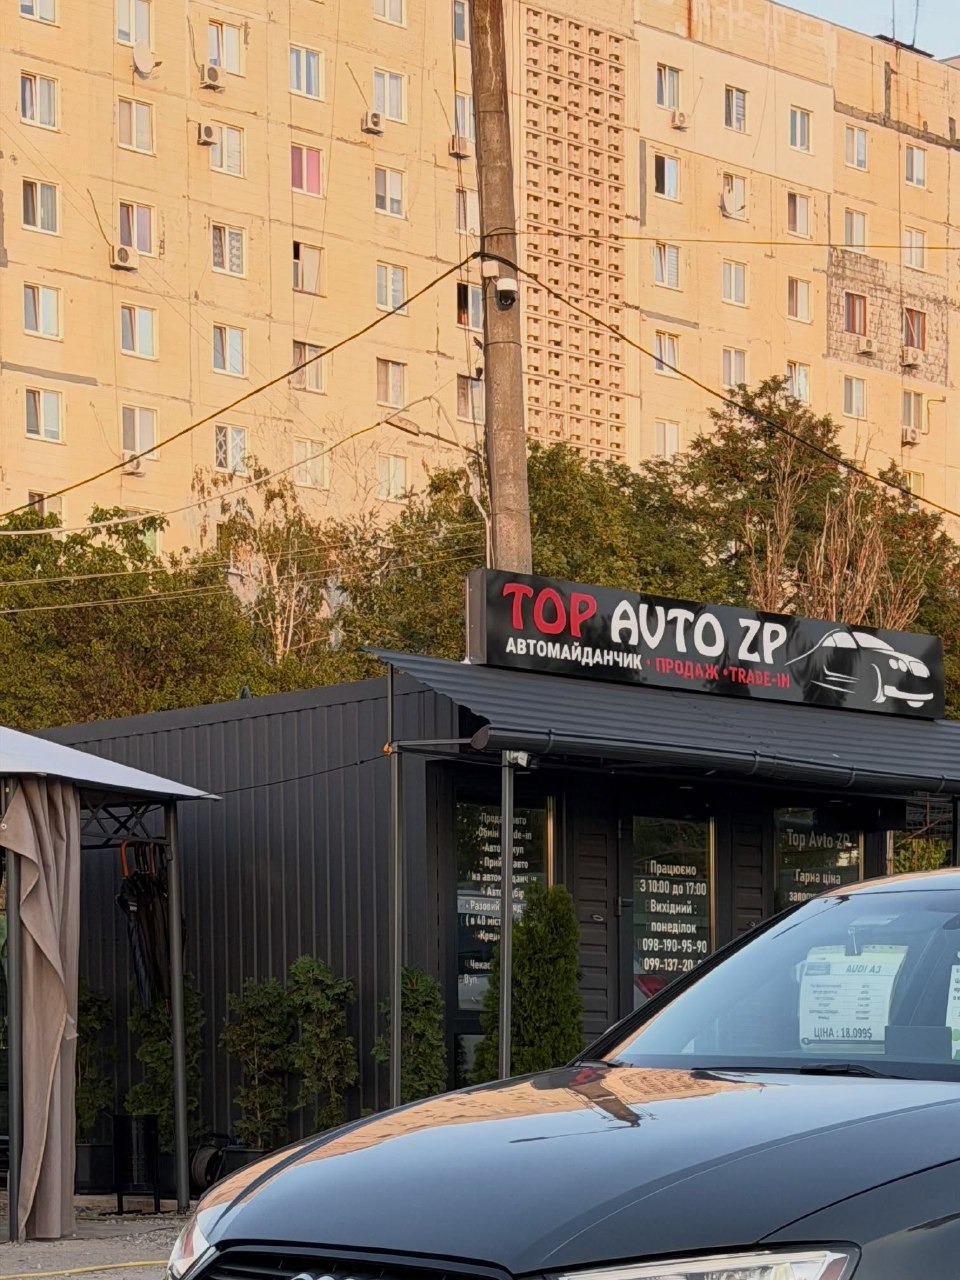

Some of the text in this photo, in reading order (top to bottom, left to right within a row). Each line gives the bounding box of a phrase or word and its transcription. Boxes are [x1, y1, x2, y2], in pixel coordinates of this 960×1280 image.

[502, 582, 598, 638] TOP
[737, 617, 788, 664] ZP
[505, 636, 790, 689] АВТОМАЙДАНЧИК ПРОДАЖ TRADE-IN
[481, 812, 503, 826] Прода
[512, 830, 532, 840] de-in
[786, 829, 806, 851] Top
[808, 830, 833, 848] Avto
[484, 856, 502, 869] Прий
[650, 860, 697, 876] Працюємо
[795, 868, 841, 886] Гарна ціна
[648, 880, 670, 893] 10:00
[672, 884, 683, 896] до
[686, 882, 707, 896] 17:00
[650, 899, 692, 915] Вихідний
[477, 915, 486, 926] 40
[488, 915, 502, 926] міст
[651, 920, 697, 934] понеділок
[642, 938, 707, 953] 098-190-95-90
[846, 964, 882, 974] AUDI A3
[814, 1026, 834, 1040] ЦІНА
[841, 1027, 873, 1040] 18.099$
